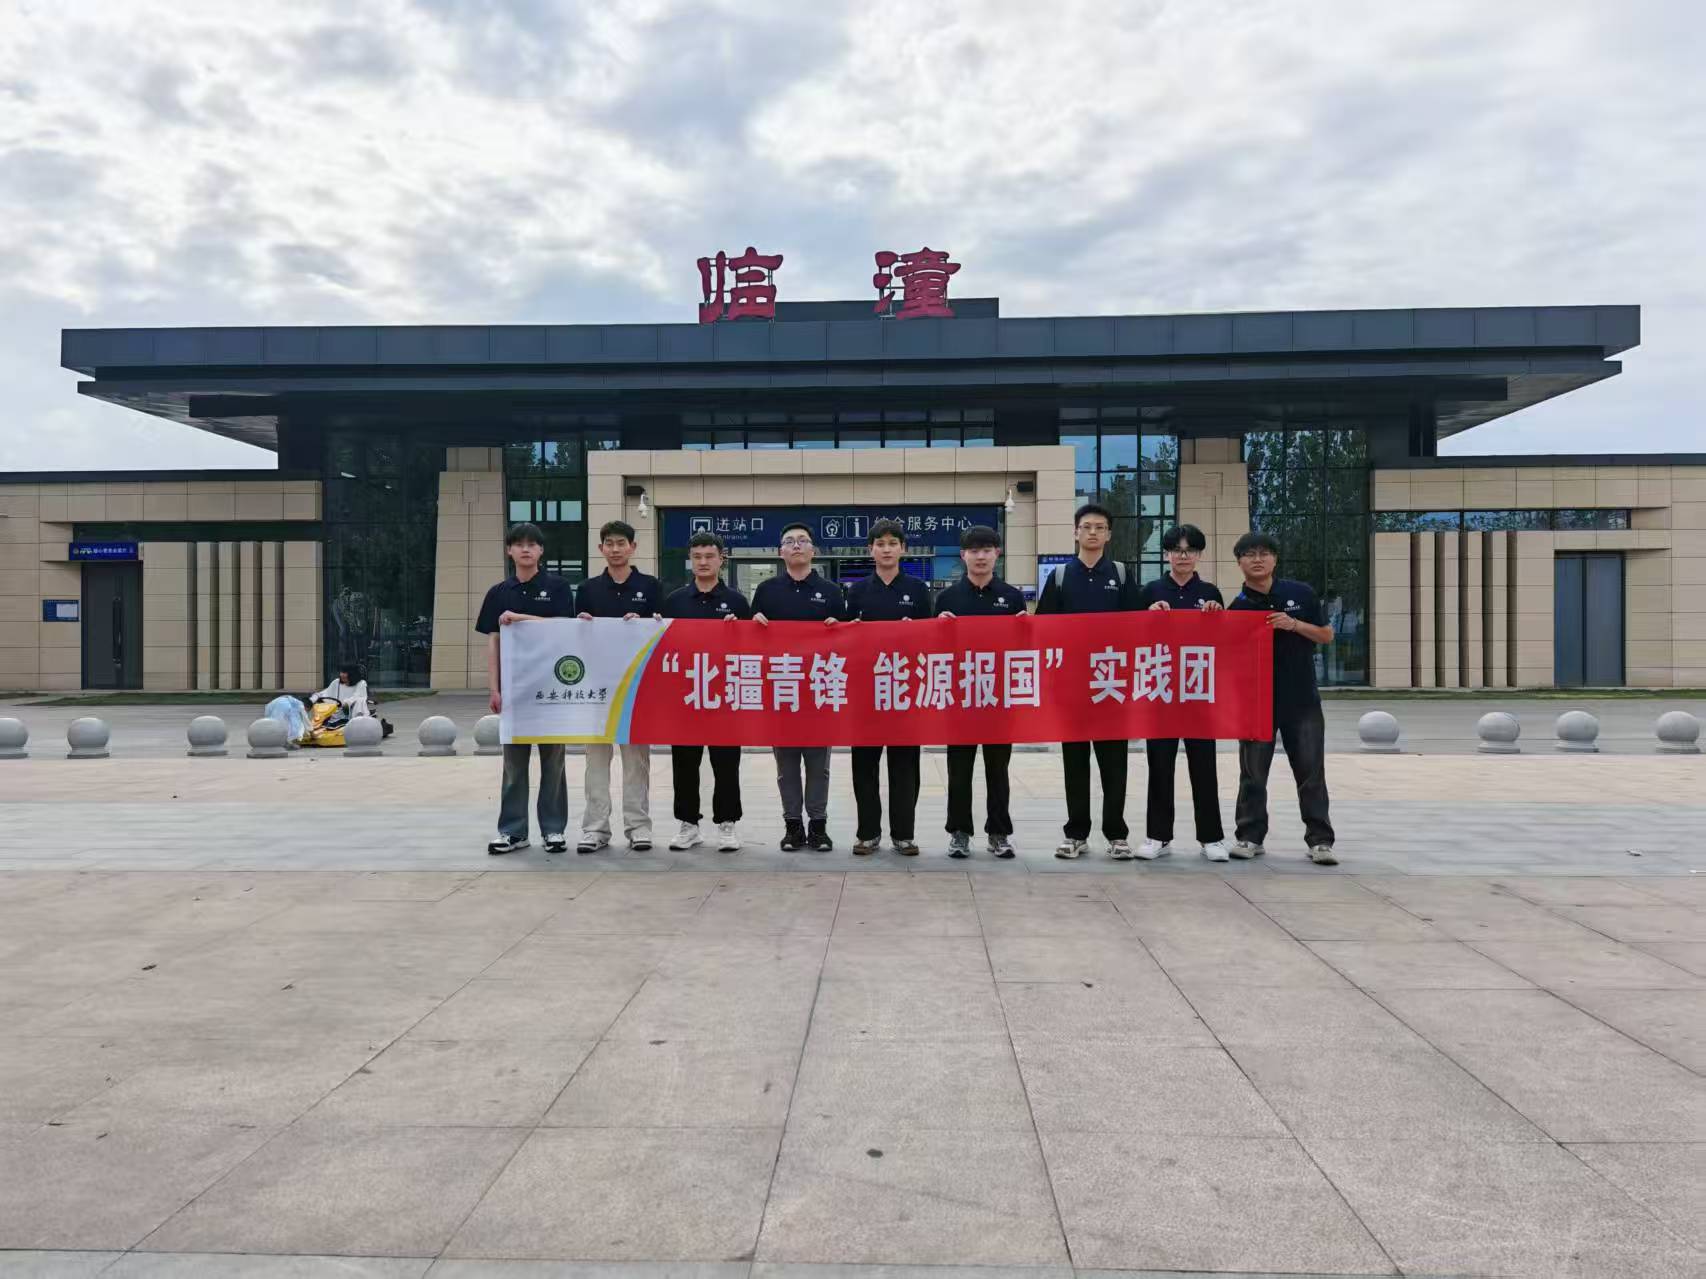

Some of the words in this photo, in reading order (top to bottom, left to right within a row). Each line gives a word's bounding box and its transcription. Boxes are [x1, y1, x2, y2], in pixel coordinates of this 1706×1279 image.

[716, 516, 763, 532] 进站口
[661, 651, 848, 713] “北疆青锋
[873, 647, 1063, 711] 能源报国”
[1089, 643, 1216, 705] 实践团
